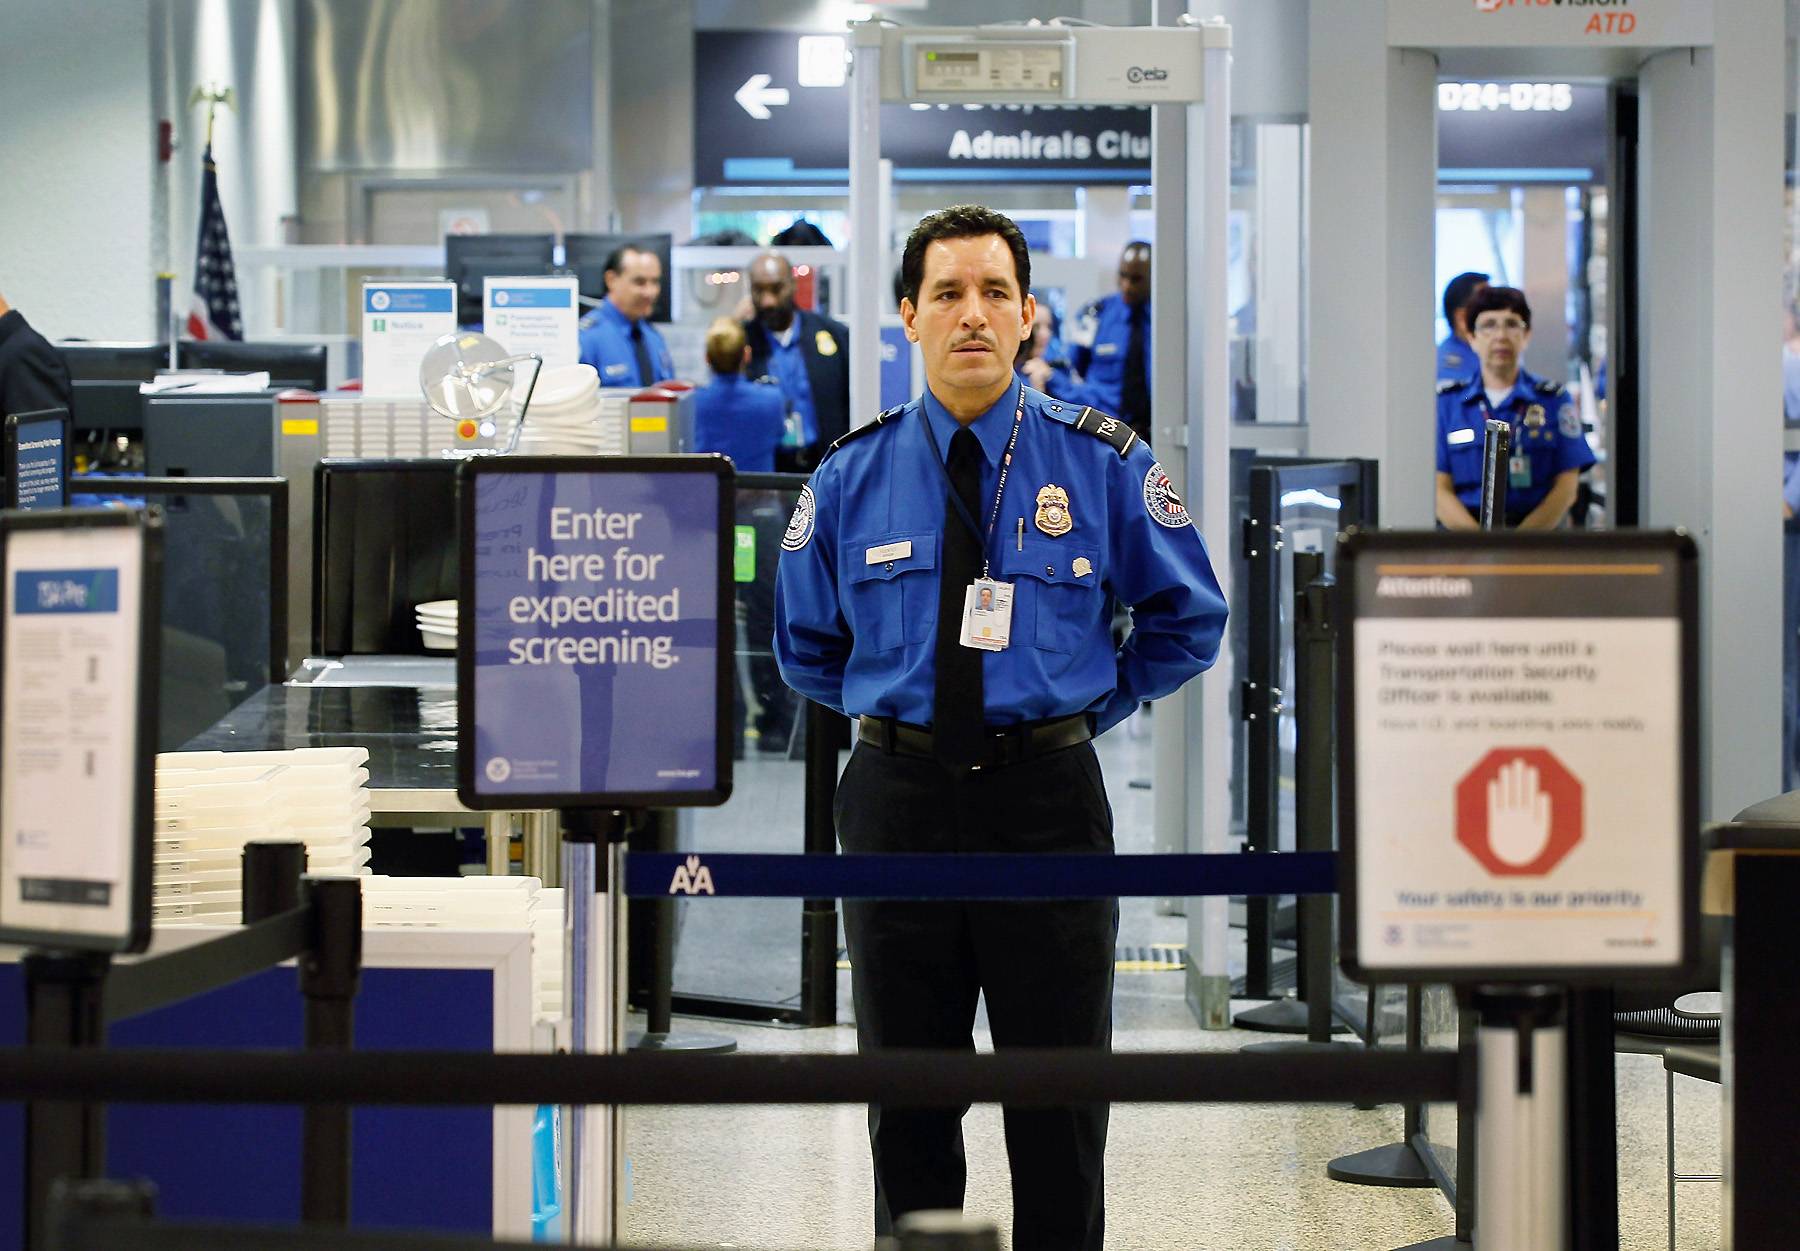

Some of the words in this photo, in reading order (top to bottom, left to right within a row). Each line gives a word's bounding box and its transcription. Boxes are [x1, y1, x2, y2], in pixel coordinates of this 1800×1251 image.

[1585, 12, 1637, 34] ATD
[1438, 83, 1573, 111] D24-D25
[949, 130, 1091, 159] Admirals
[1097, 130, 1152, 159] Clu
[1096, 416, 1120, 437] TSA
[550, 507, 642, 540] Enter
[527, 547, 605, 581] here
[613, 547, 664, 581] for
[1376, 577, 1472, 597] Attention
[509, 587, 680, 629] expedited
[508, 629, 680, 669] screening.
